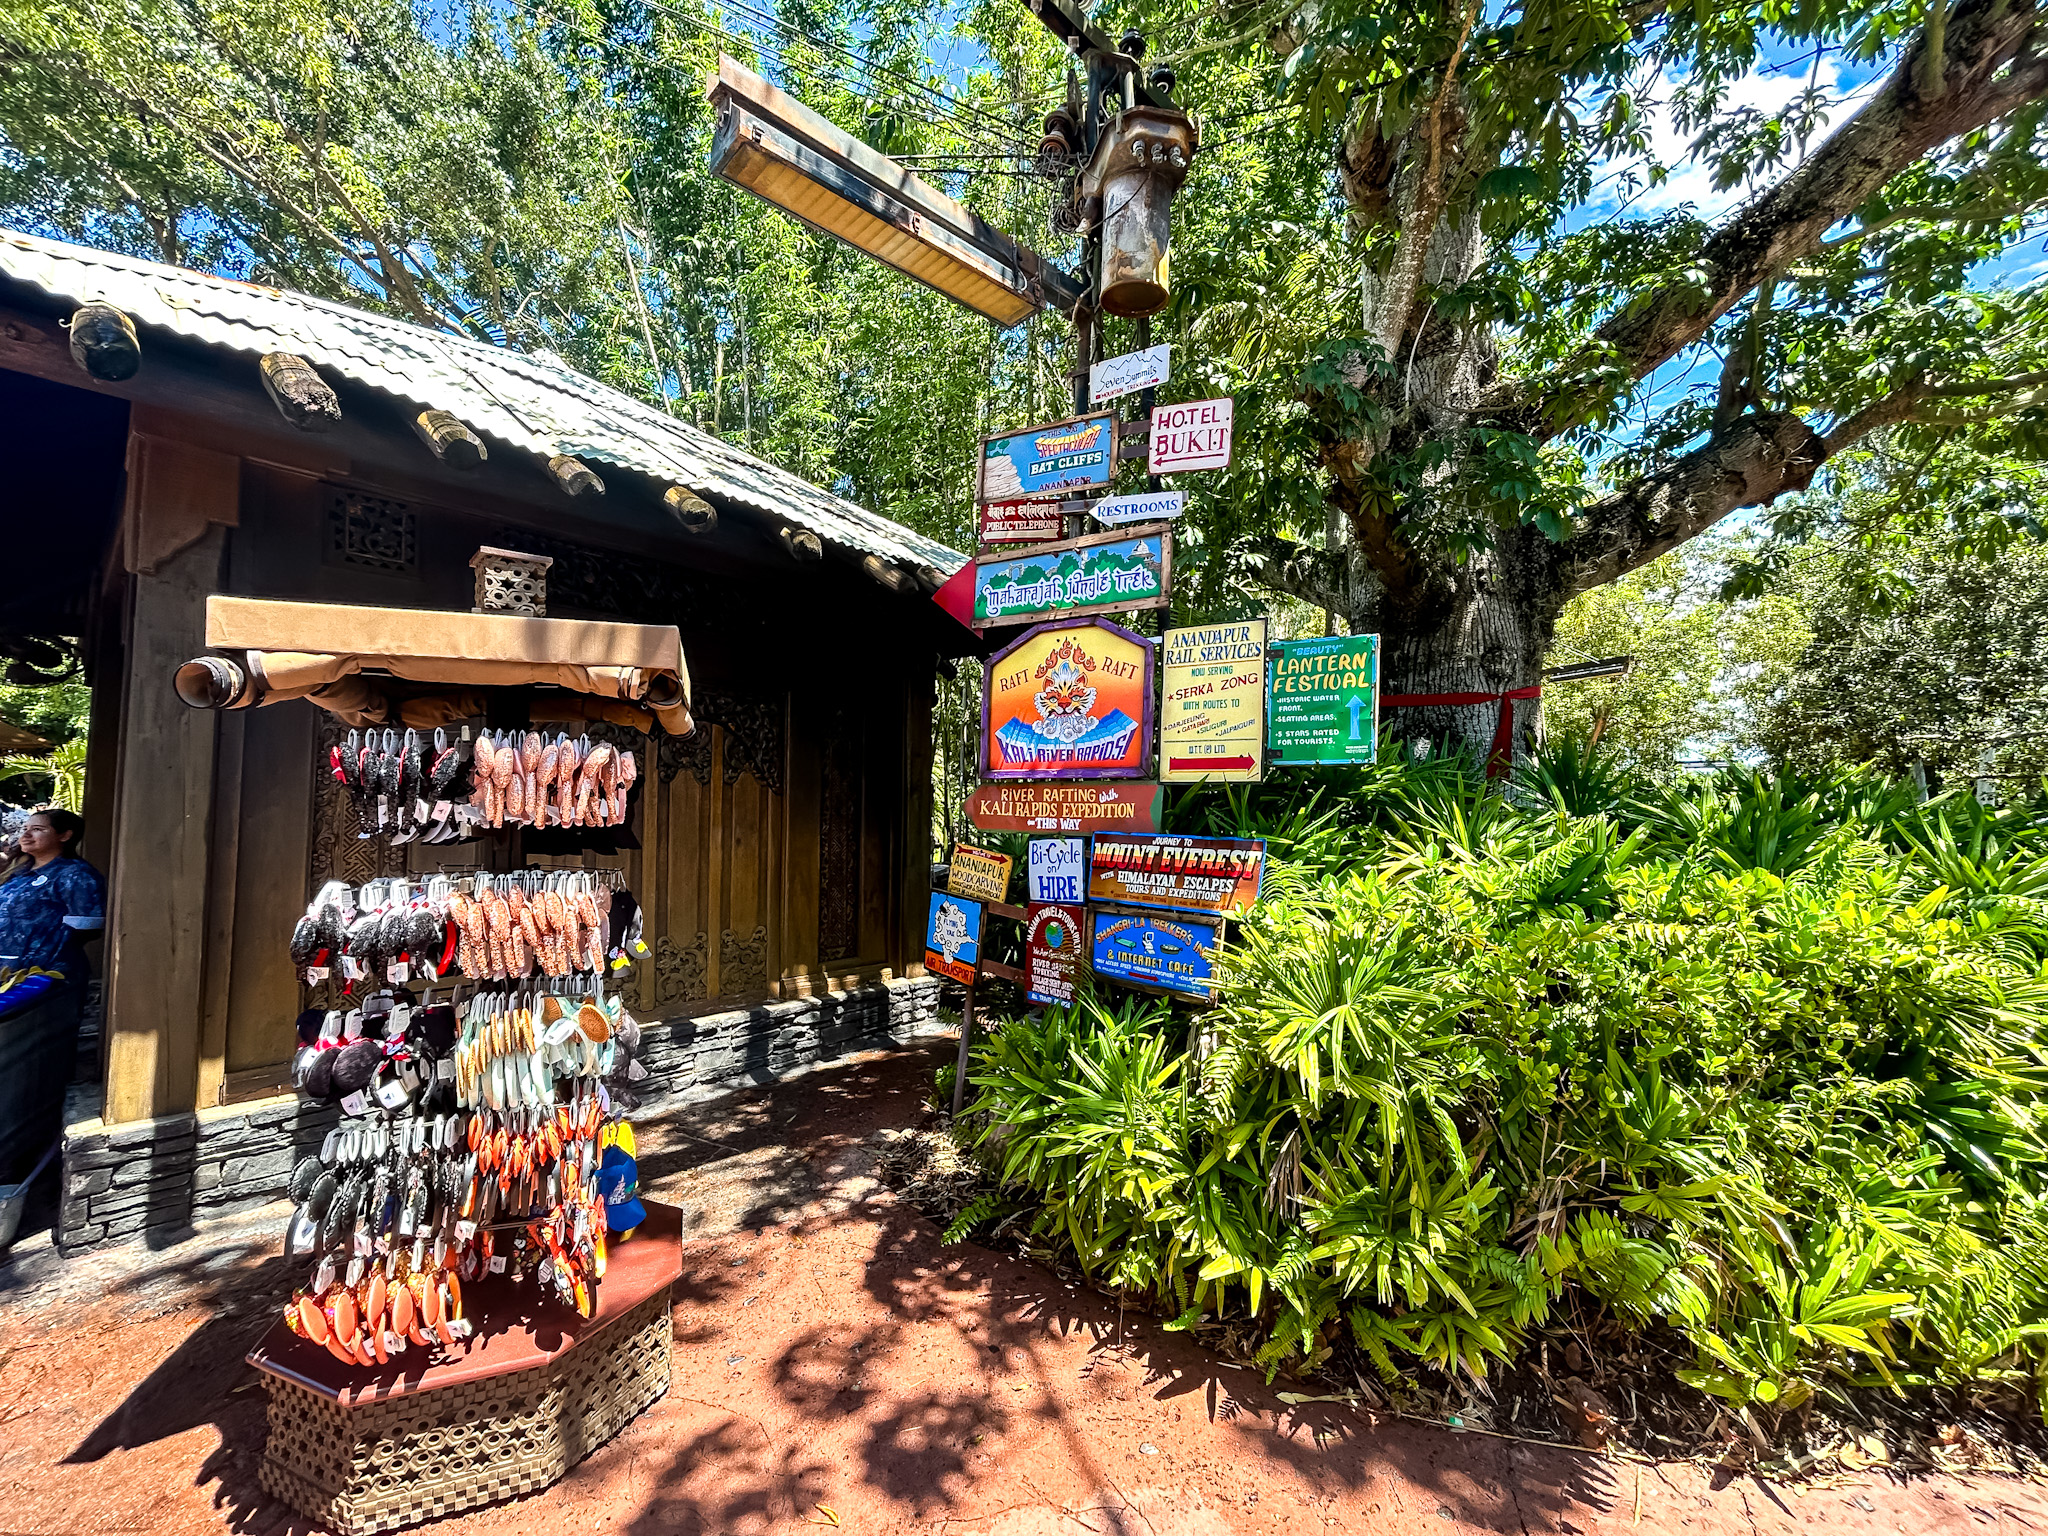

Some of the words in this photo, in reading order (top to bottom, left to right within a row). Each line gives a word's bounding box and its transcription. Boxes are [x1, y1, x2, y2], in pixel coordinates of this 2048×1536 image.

[1096, 374, 1125, 393] Seven
[1125, 365, 1157, 385] Summits
[1101, 387, 1124, 398] MOUNTAIN
[1127, 380, 1150, 391] TREKKING
[1158, 405, 1221, 431] HOTEL
[1034, 424, 1103, 459] SPECTACULAR
[1047, 430, 1061, 438] THIS
[1065, 424, 1080, 434] WAY
[1155, 427, 1229, 457] BUKIT
[1030, 460, 1054, 475] BAT
[1057, 451, 1102, 468] CLIFFS
[1039, 476, 1092, 491] ANANDAPUR
[1097, 499, 1179, 517] RESTROOMS
[986, 521, 1013, 531] PUBLIC
[1013, 520, 1059, 530] TELEPHONE
[1171, 626, 1251, 649] ANANDAPUR
[1165, 648, 1197, 666] RAIL
[1200, 641, 1262, 662] SERVICES
[1276, 652, 1368, 676] LANTERN
[1101, 656, 1139, 680] RAFT
[1191, 667, 1206, 677] NOW
[1207, 665, 1233, 676] SERVING
[999, 668, 1031, 692] RAFT
[1175, 682, 1214, 701] SERKA
[1220, 672, 1258, 691] ZONG
[1272, 671, 1370, 694] FESTIVAL
[1183, 700, 1200, 710] WITH
[1203, 698, 1228, 710] ROUTES
[1231, 698, 1240, 708] TO
[1312, 694, 1340, 702] WATER
[1167, 712, 1206, 730] DARJEELING
[1285, 729, 1310, 737] STARS
[1312, 728, 1340, 736] RATED
[1277, 738, 1292, 746] FOR
[979, 800, 1015, 817] KALI
[1015, 802, 1058, 818] RAPIDS
[1062, 802, 1136, 819] EXPEDITION
[1035, 817, 1058, 830] THIS
[1060, 818, 1082, 831] WAY
[1152, 836, 1181, 846] JOURNEY
[1183, 838, 1193, 847] TO
[953, 854, 1005, 881] ANANDAPUR
[1031, 842, 1081, 870] Bi-Cycle
[1092, 842, 1161, 871] MOUNT
[1160, 846, 1263, 880] EVEREST
[951, 867, 1004, 893] WOODCARVING
[1047, 864, 1057, 874] on
[1038, 875, 1079, 901] HIRE
[1117, 870, 1177, 888] HIMALAYAN
[1182, 875, 1235, 894] ESCAPES
[1125, 883, 1150, 895] TOURS
[1151, 886, 1167, 896] AND
[1167, 887, 1222, 902] EXPEDITIONS
[1095, 917, 1145, 945] SHANGRI-LA
[1150, 918, 1194, 946] TREKKER'S
[925, 955, 936, 969] AIR
[938, 959, 975, 983] TRANSPORT
[1032, 957, 1051, 969] RIVER
[1107, 950, 1115, 960] &
[1117, 951, 1163, 969] INTERNET
[1167, 960, 1195, 976] CAFÉ
